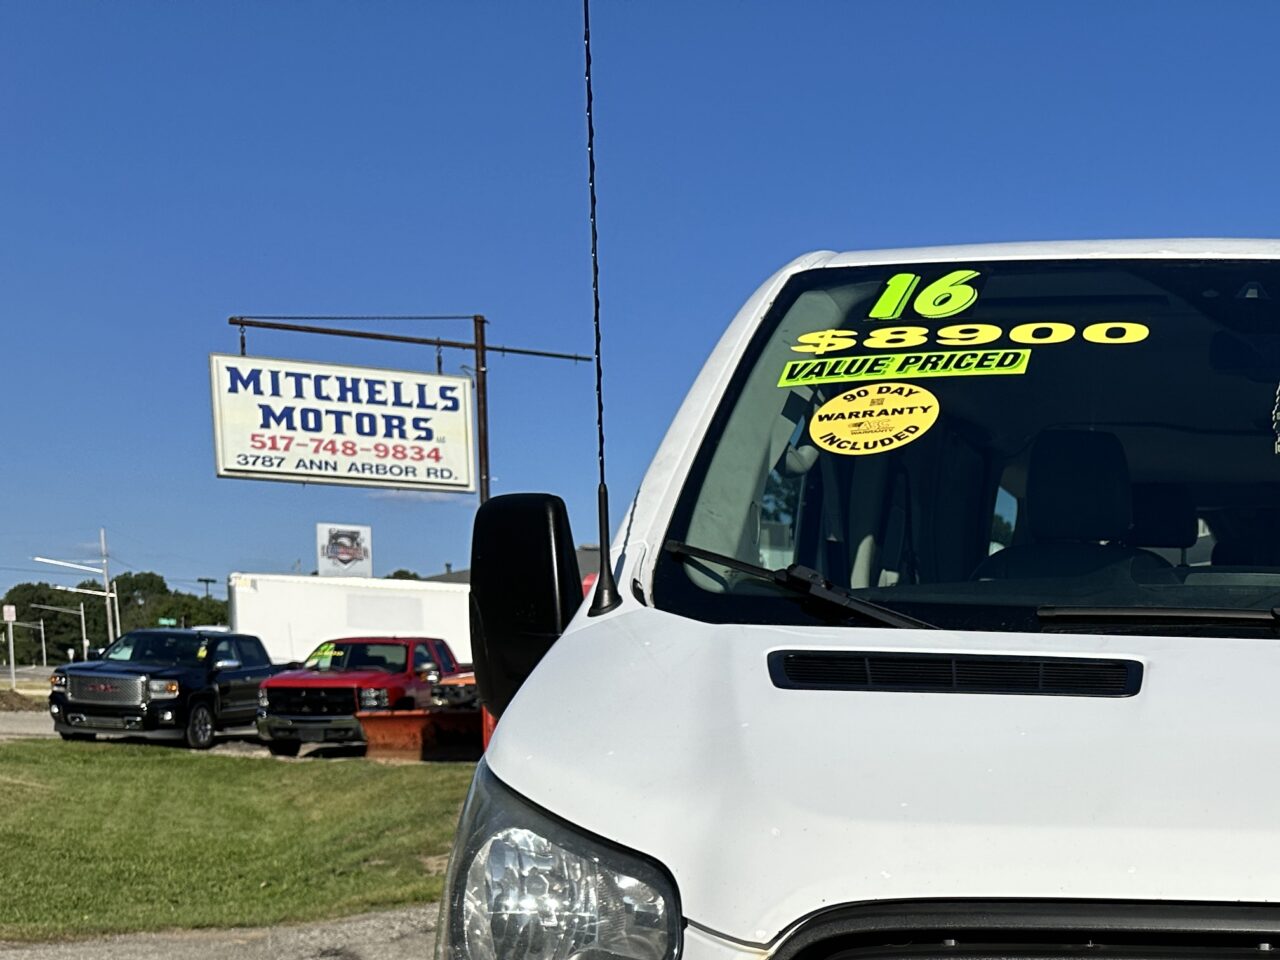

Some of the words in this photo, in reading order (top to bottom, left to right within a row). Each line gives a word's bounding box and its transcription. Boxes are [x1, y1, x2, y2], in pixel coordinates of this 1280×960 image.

[868, 269, 982, 320] 16
[790, 322, 1150, 354] $8900
[785, 354, 896, 382] VALUE
[898, 350, 1028, 374] PRICED
[225, 366, 460, 412] MITCHELLS
[842, 389, 869, 403] 90
[877, 385, 920, 398] DAY
[257, 403, 434, 442] MOTORS
[818, 405, 933, 422] WARRANTY
[250, 433, 443, 463] 517-748-9834
[819, 425, 921, 451] INCLUDED
[236, 453, 286, 469] 3787
[295, 457, 338, 472] ANN
[347, 462, 418, 479] ARBOR
[426, 466, 459, 481] RD.
